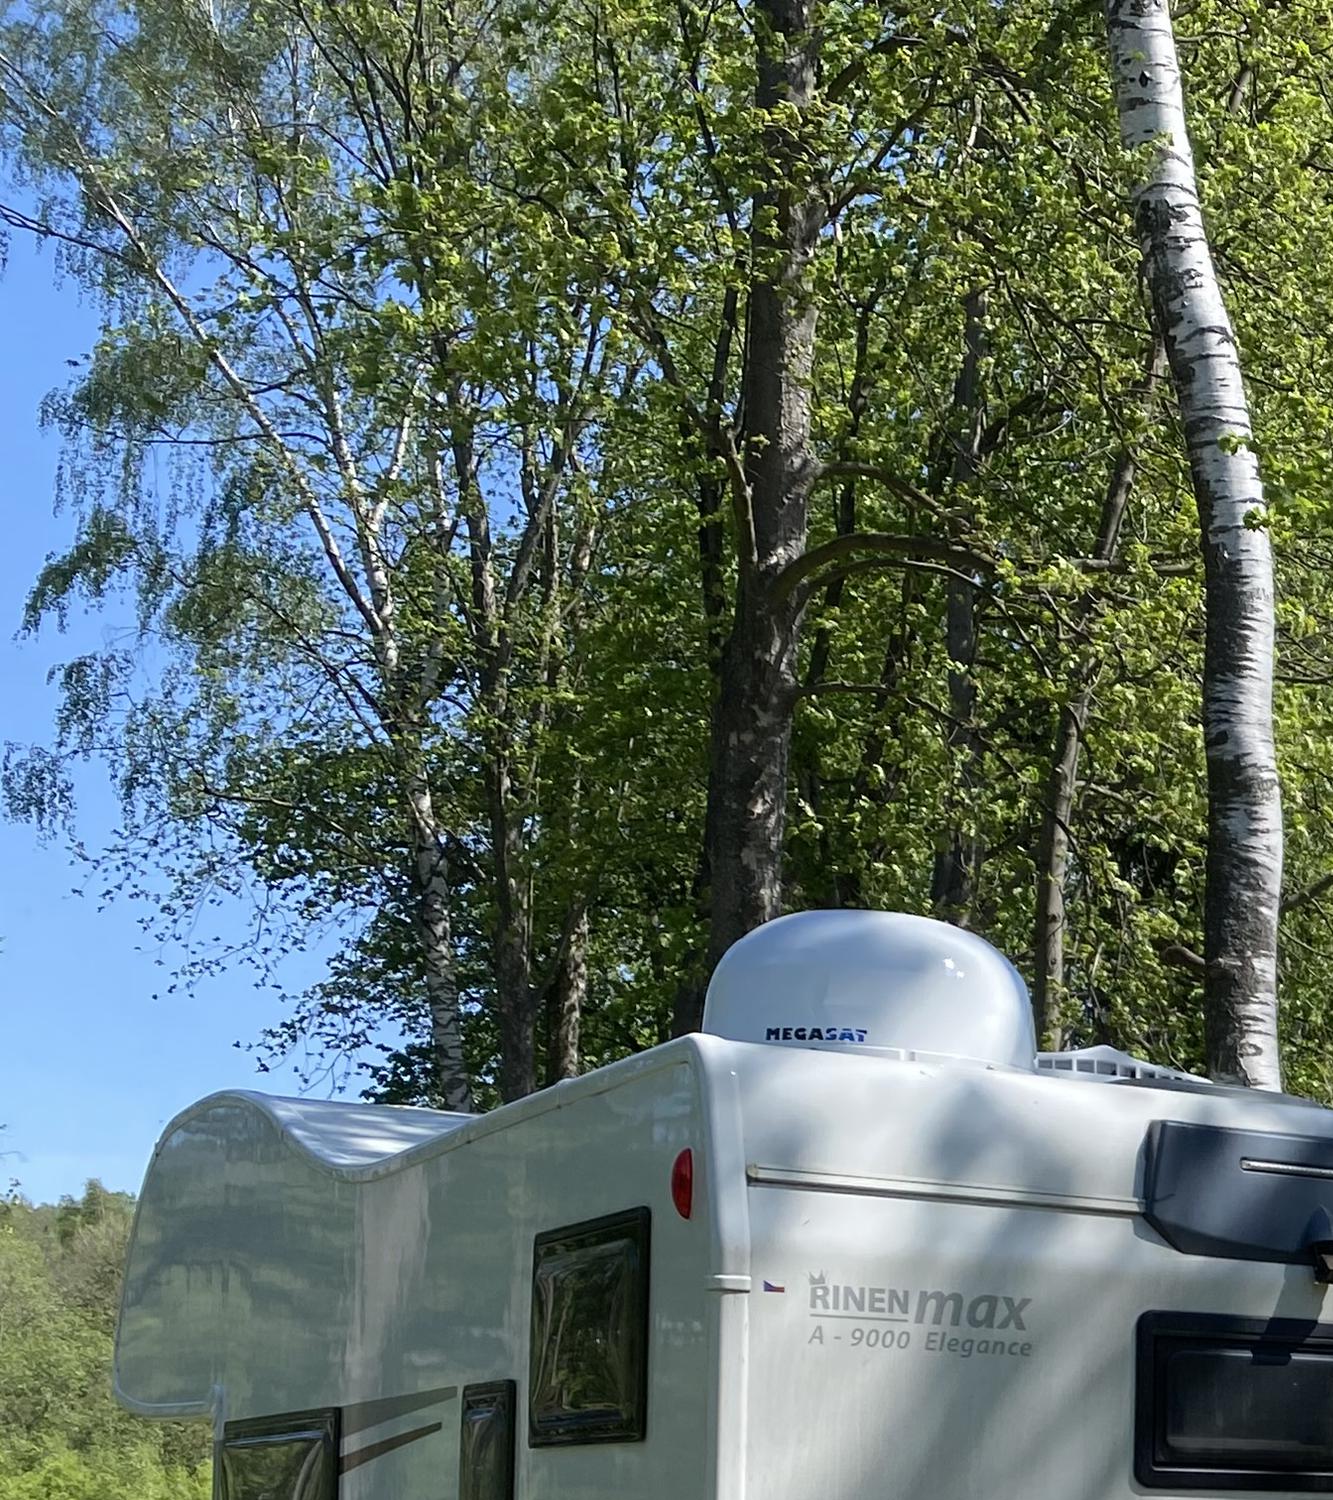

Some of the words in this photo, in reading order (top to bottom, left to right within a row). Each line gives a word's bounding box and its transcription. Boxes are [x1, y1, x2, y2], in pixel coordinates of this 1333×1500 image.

[765, 1027, 868, 1043] MEGASAT
[807, 1325, 825, 1345] A
[850, 1328, 911, 1350] 9000
[924, 1331, 1033, 1359] Elegance
